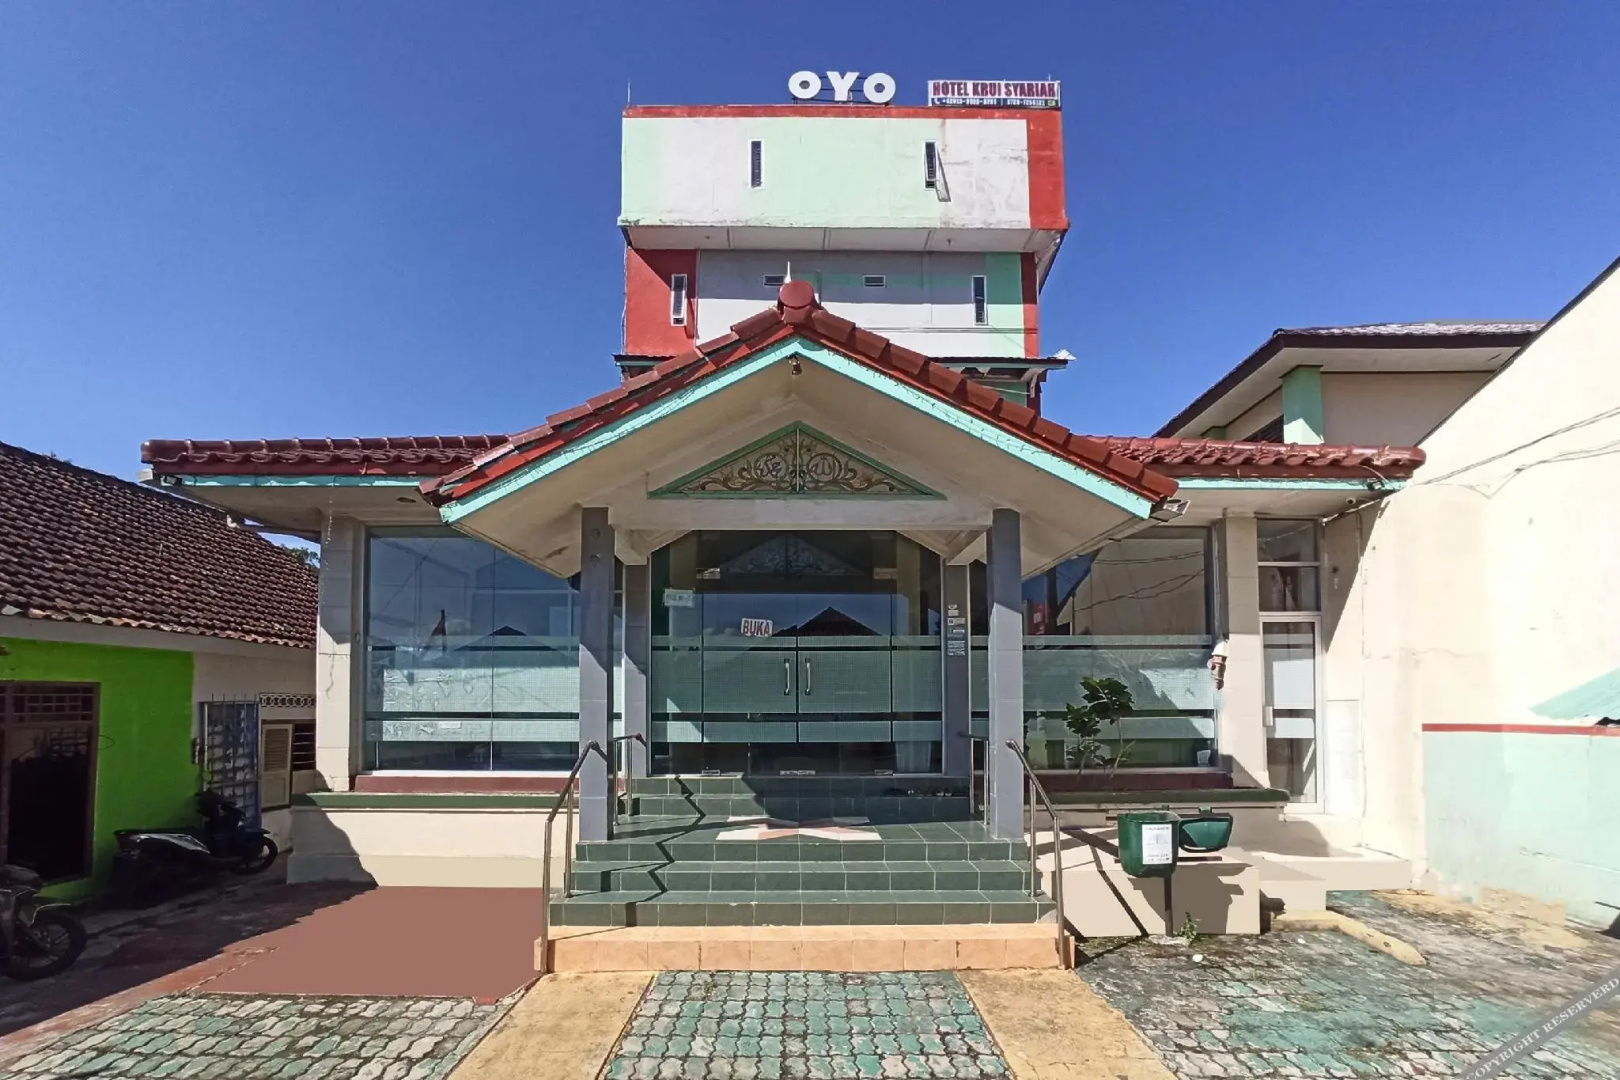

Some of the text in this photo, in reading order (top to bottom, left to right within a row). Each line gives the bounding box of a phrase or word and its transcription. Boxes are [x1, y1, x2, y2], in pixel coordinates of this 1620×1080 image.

[788, 70, 896, 103] OYO
[932, 81, 1056, 97] HOTEL KRUI SYARIAH
[743, 619, 771, 635] BUKA
